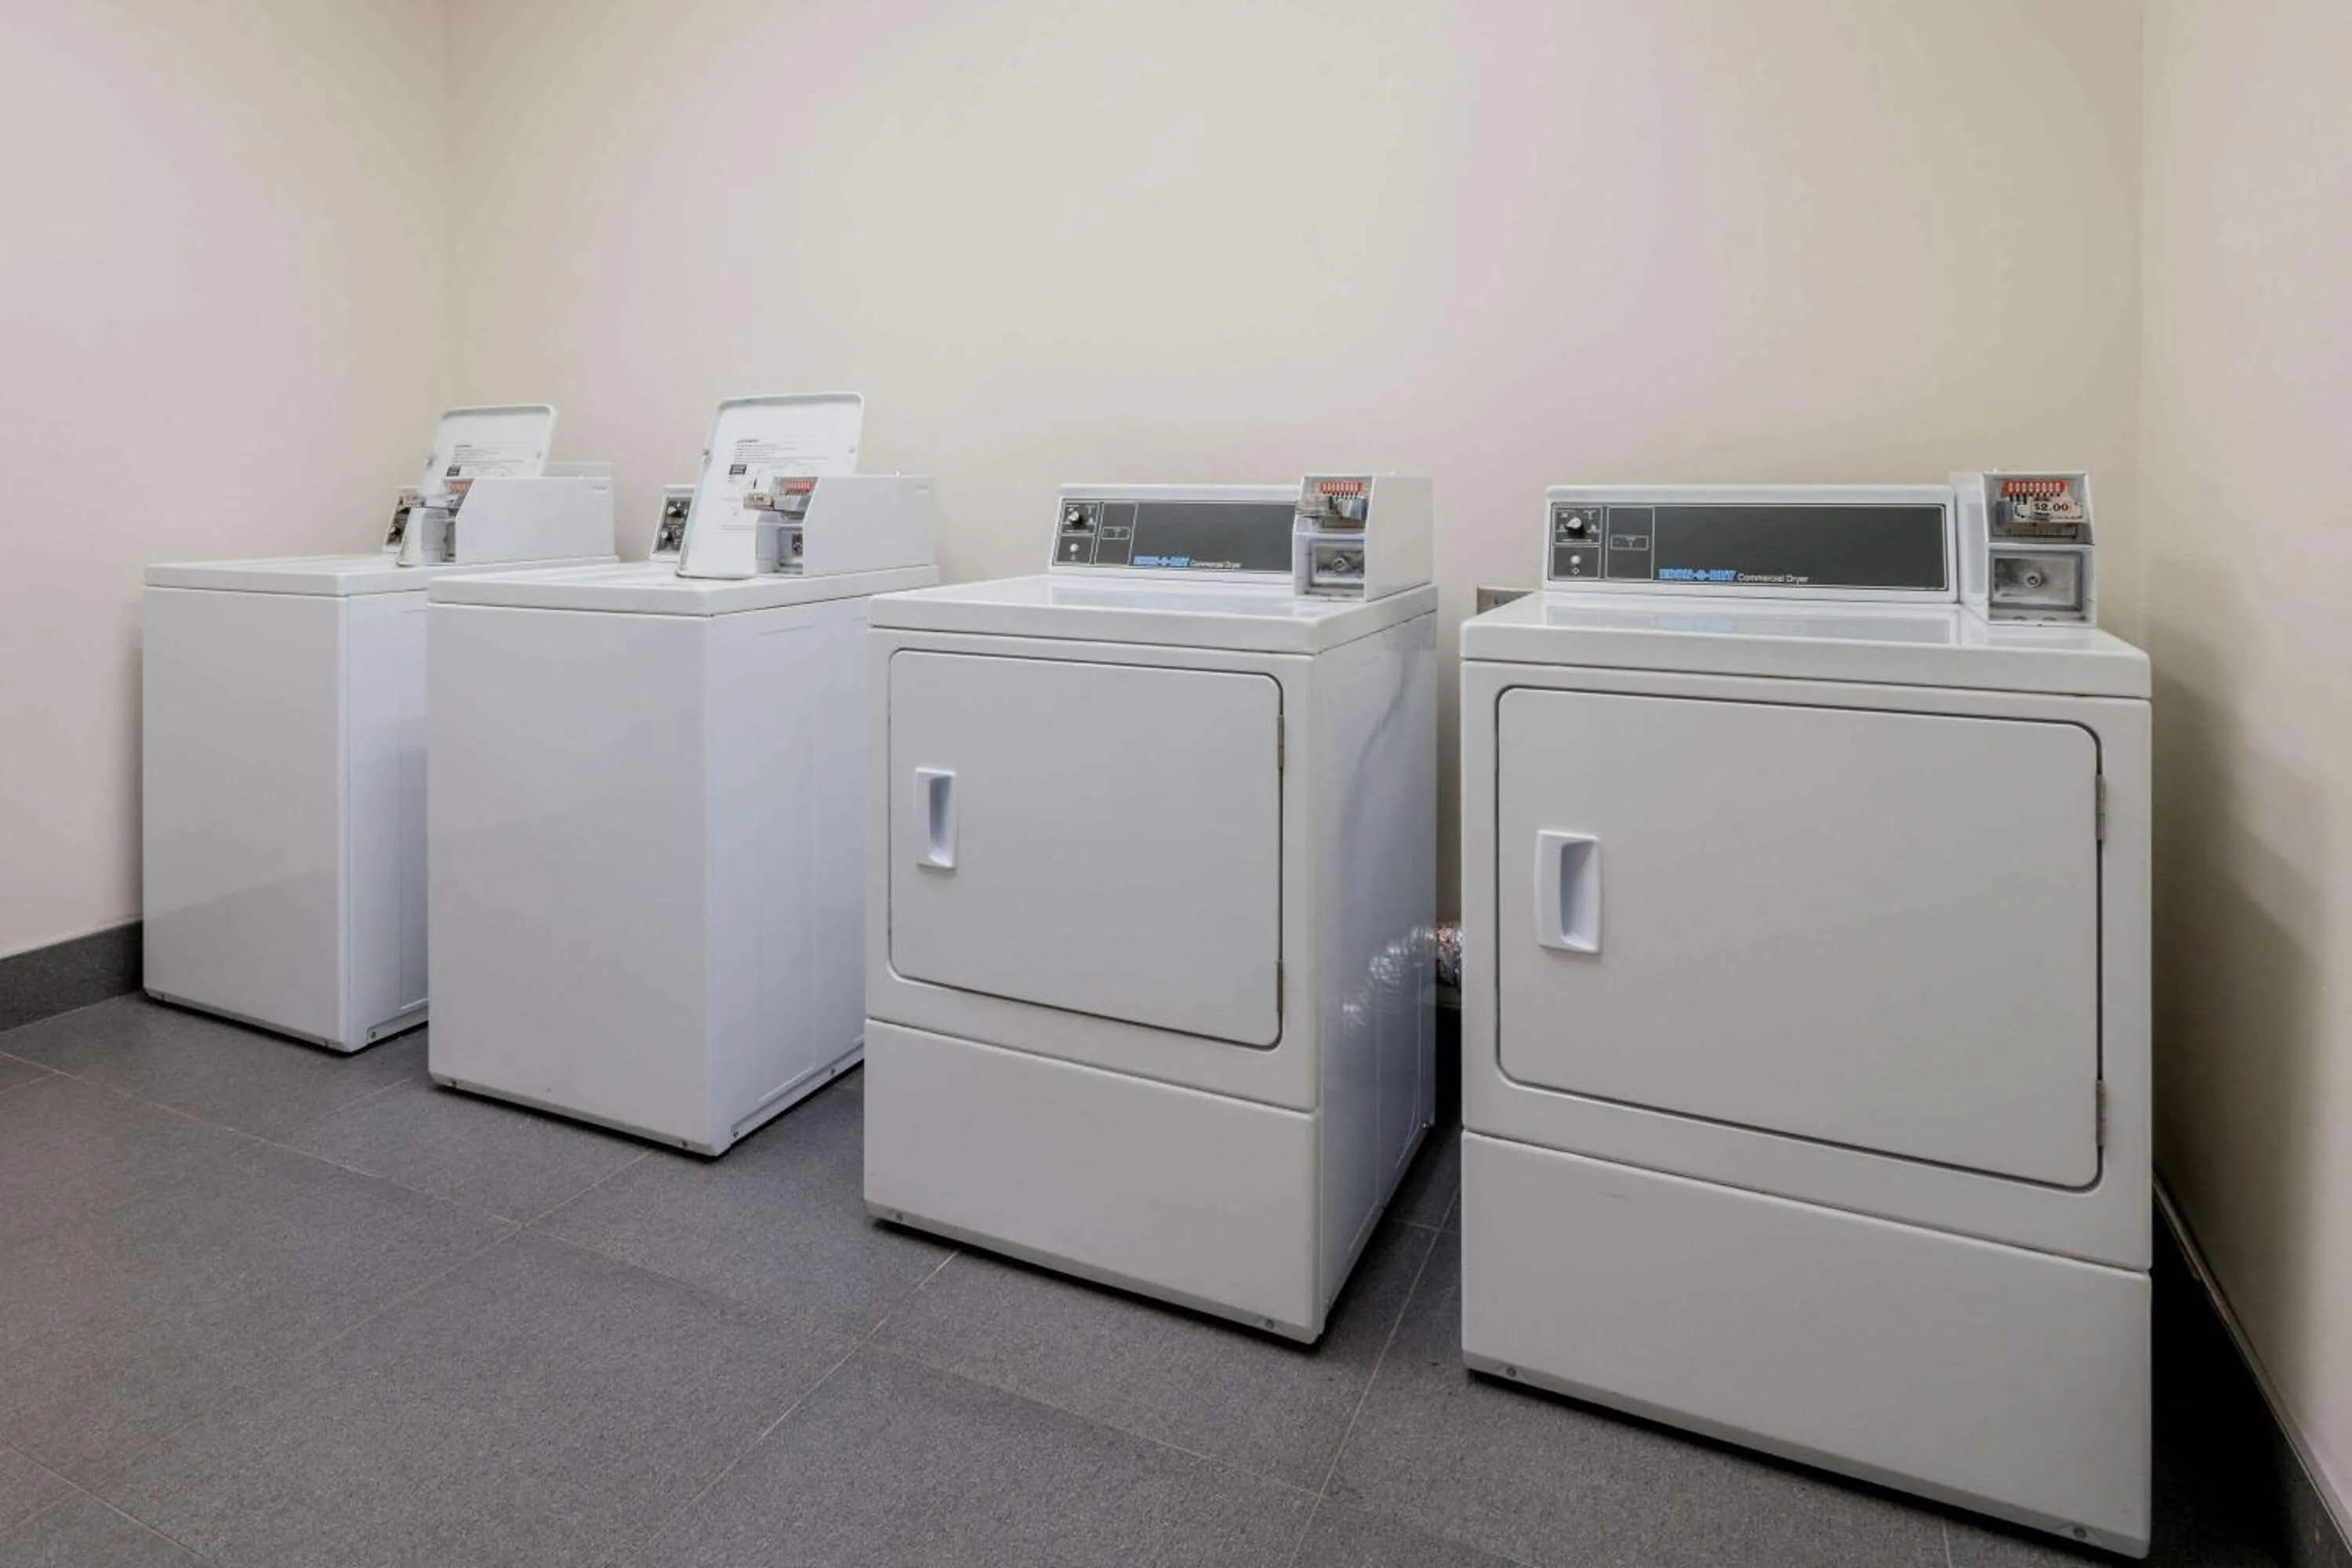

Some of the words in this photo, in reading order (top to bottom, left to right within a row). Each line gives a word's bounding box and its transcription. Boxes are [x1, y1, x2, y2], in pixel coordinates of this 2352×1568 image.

[2034, 503, 2069, 512] $2.00
[1737, 573, 1785, 583] Commercial
[1786, 575, 1809, 586] Dryer
